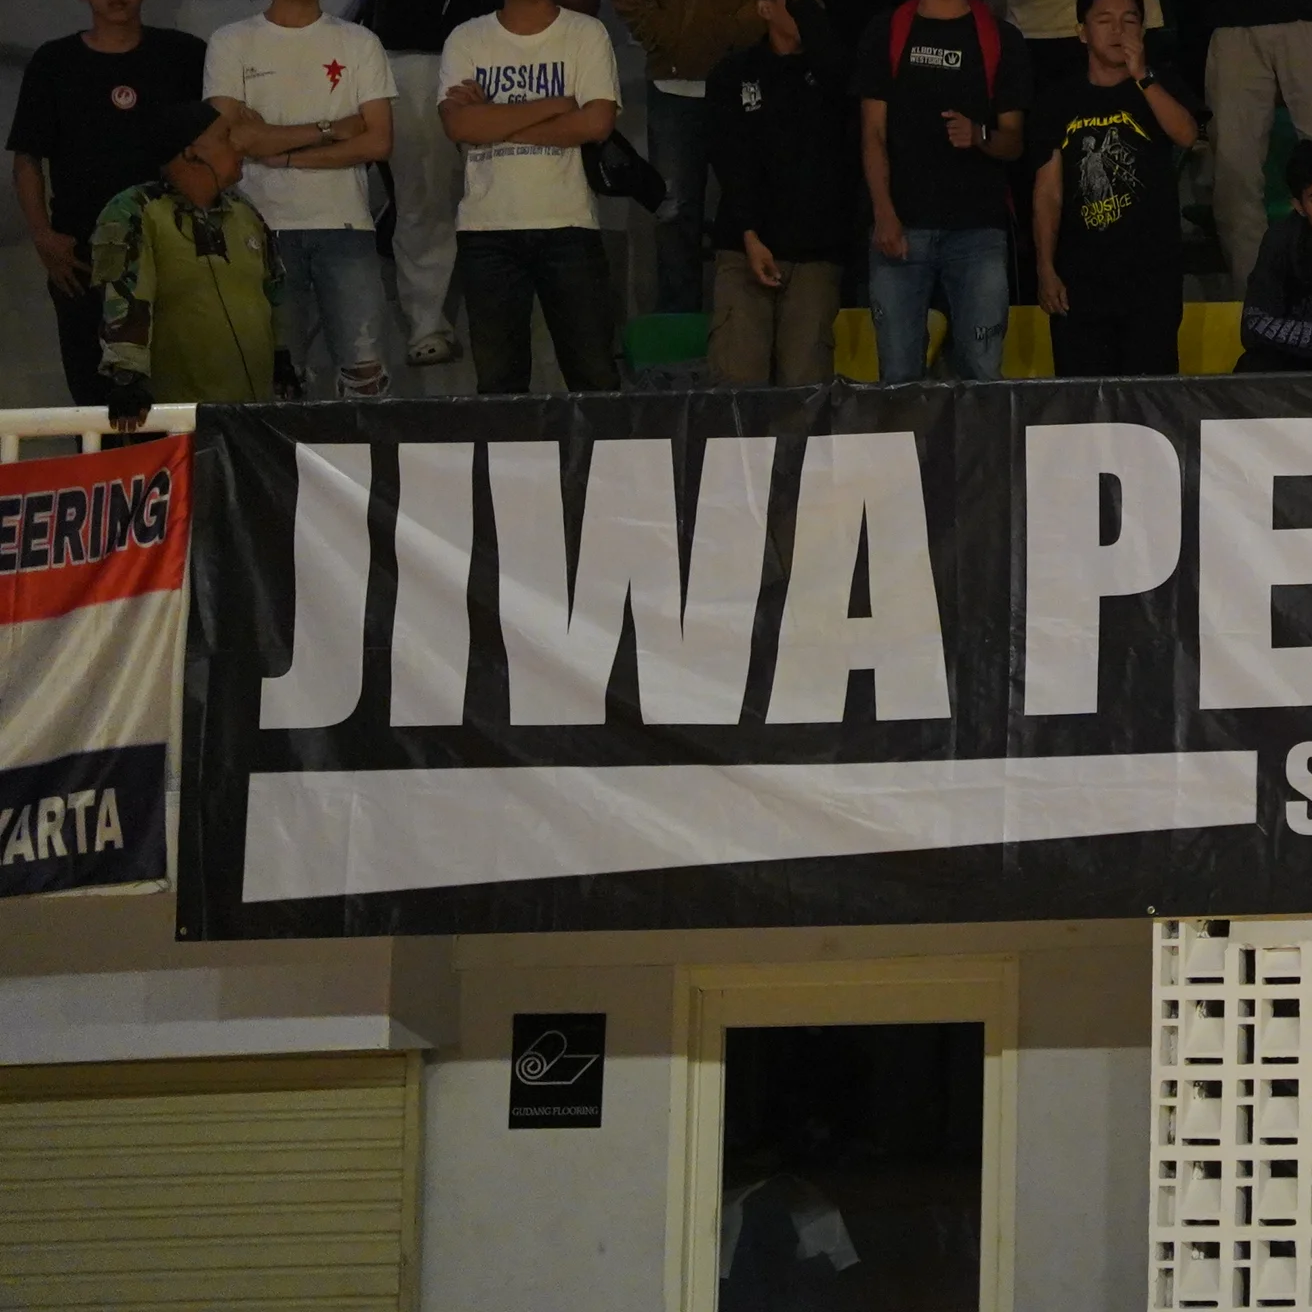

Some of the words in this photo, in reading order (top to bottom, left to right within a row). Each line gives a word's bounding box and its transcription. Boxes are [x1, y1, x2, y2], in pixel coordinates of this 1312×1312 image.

[1091, 193, 1132, 216] JUSTICE
[1084, 214, 1104, 230] FOR
[259, 431, 951, 730] JIWA
[512, 1106, 551, 1116] GUDANG
[552, 1106, 599, 1116] FLOORING
